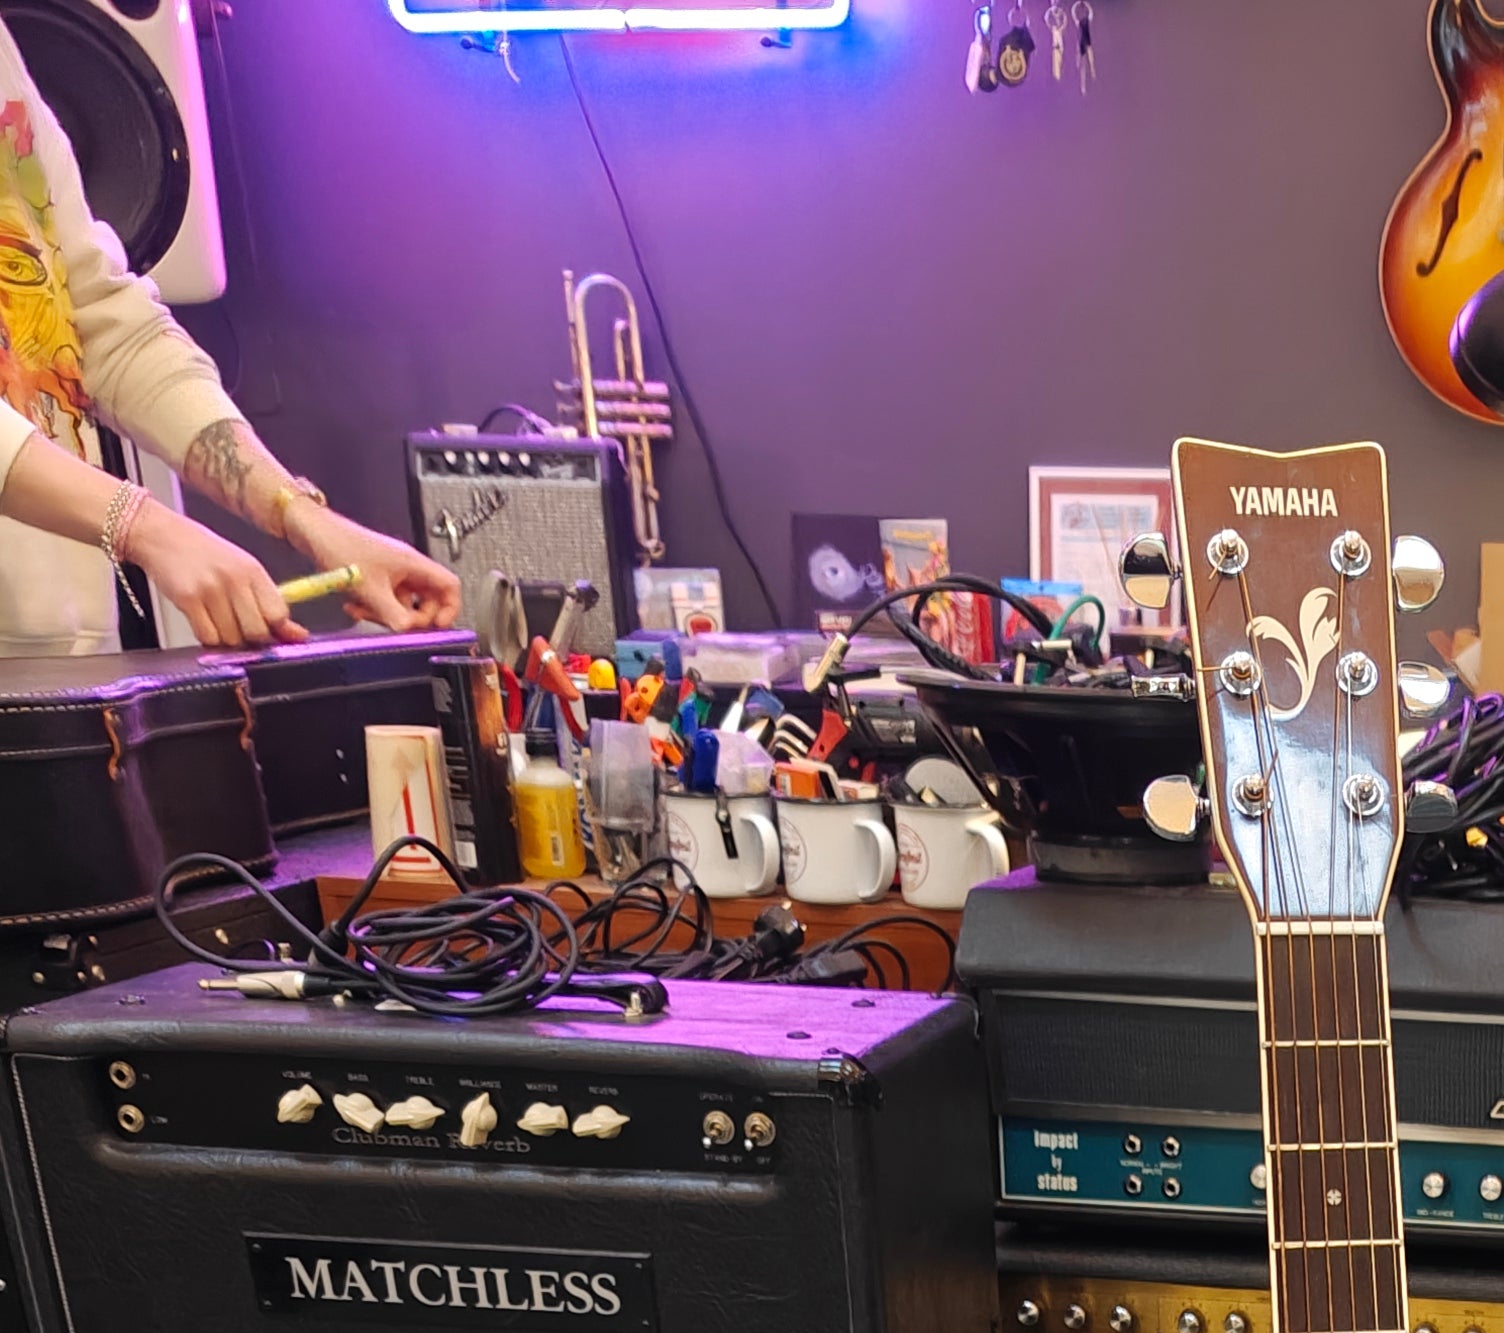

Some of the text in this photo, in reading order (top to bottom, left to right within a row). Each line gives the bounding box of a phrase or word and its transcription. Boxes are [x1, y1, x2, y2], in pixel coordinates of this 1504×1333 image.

[1229, 486, 1339, 517] YAMAHA
[332, 1127, 531, 1153] Clubman Rverb
[1034, 1130, 1078, 1150] Impact
[1051, 1154, 1062, 1172] by
[1037, 1174, 1078, 1192] status
[284, 1256, 622, 1316] MATCHLESS
